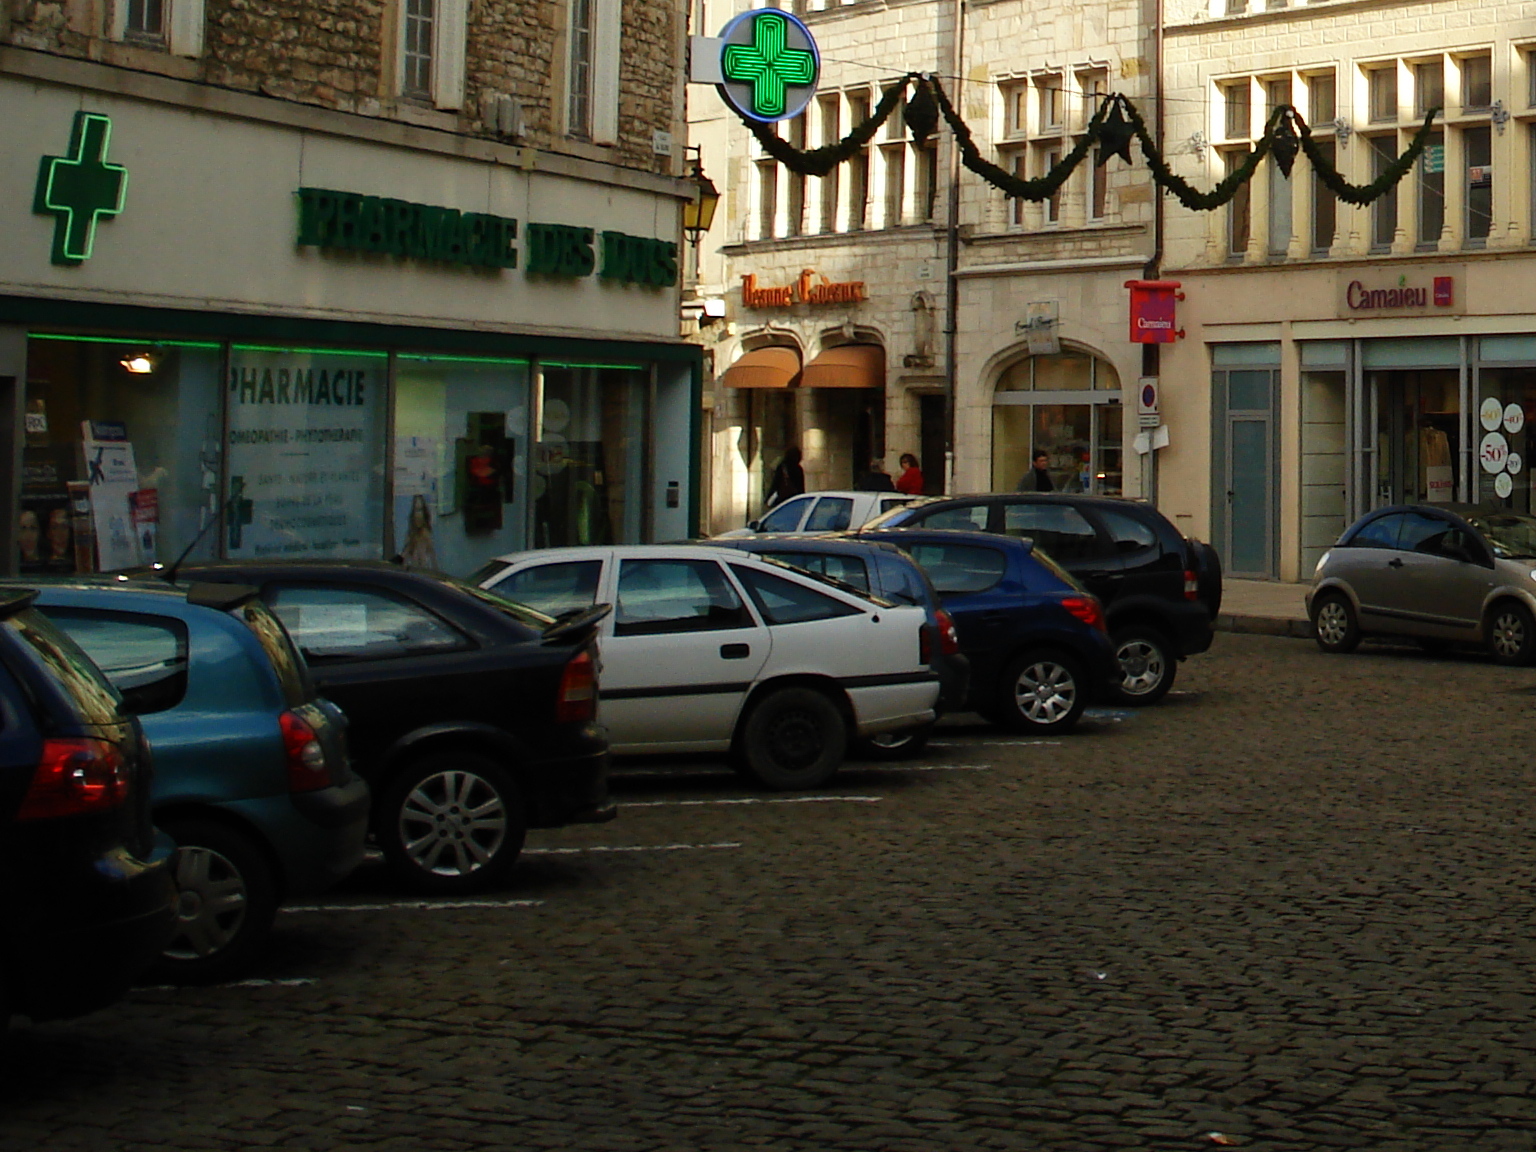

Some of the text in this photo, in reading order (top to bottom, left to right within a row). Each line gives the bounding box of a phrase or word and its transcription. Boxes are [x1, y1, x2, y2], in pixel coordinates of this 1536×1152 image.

[297, 186, 518, 269] PHARMACIE
[525, 221, 595, 277] DES
[230, 366, 365, 405] PHARMACIE
[230, 429, 288, 444] OMEOPATHIE
